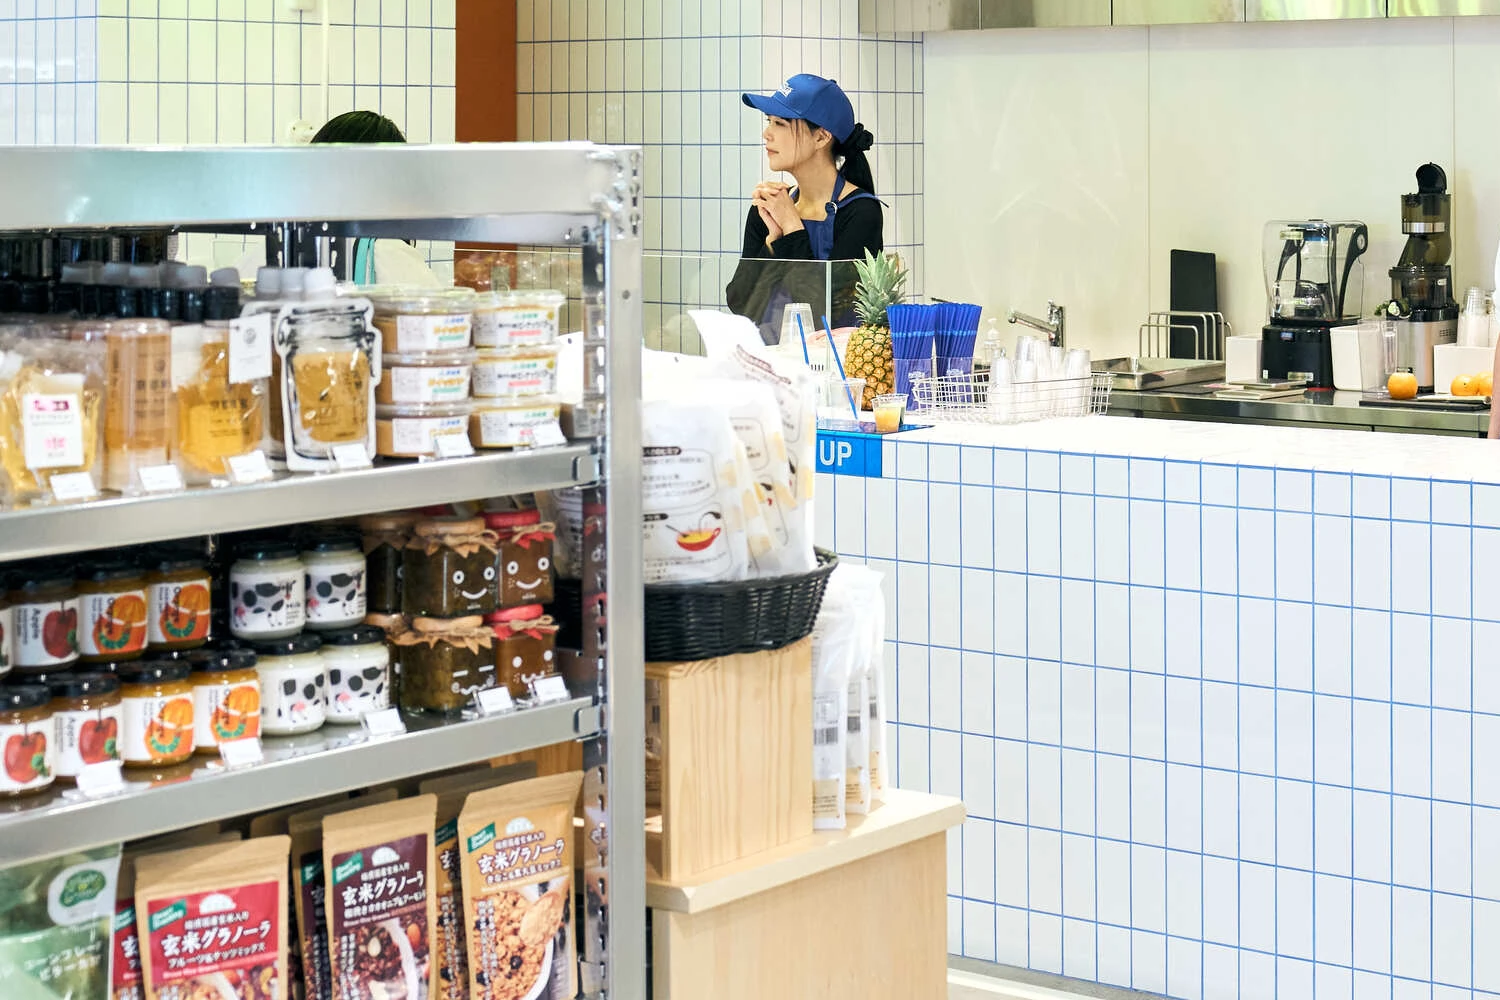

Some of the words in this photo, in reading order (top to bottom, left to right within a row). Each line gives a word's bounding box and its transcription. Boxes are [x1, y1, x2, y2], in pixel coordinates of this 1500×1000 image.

[820, 440, 852, 467] UP
[32, 608, 41, 639] Apple
[478, 839, 565, 875] 玄米グラノーラ
[341, 870, 425, 908] 玄米グラノーラ
[160, 919, 272, 958] 玄米グラノーラ
